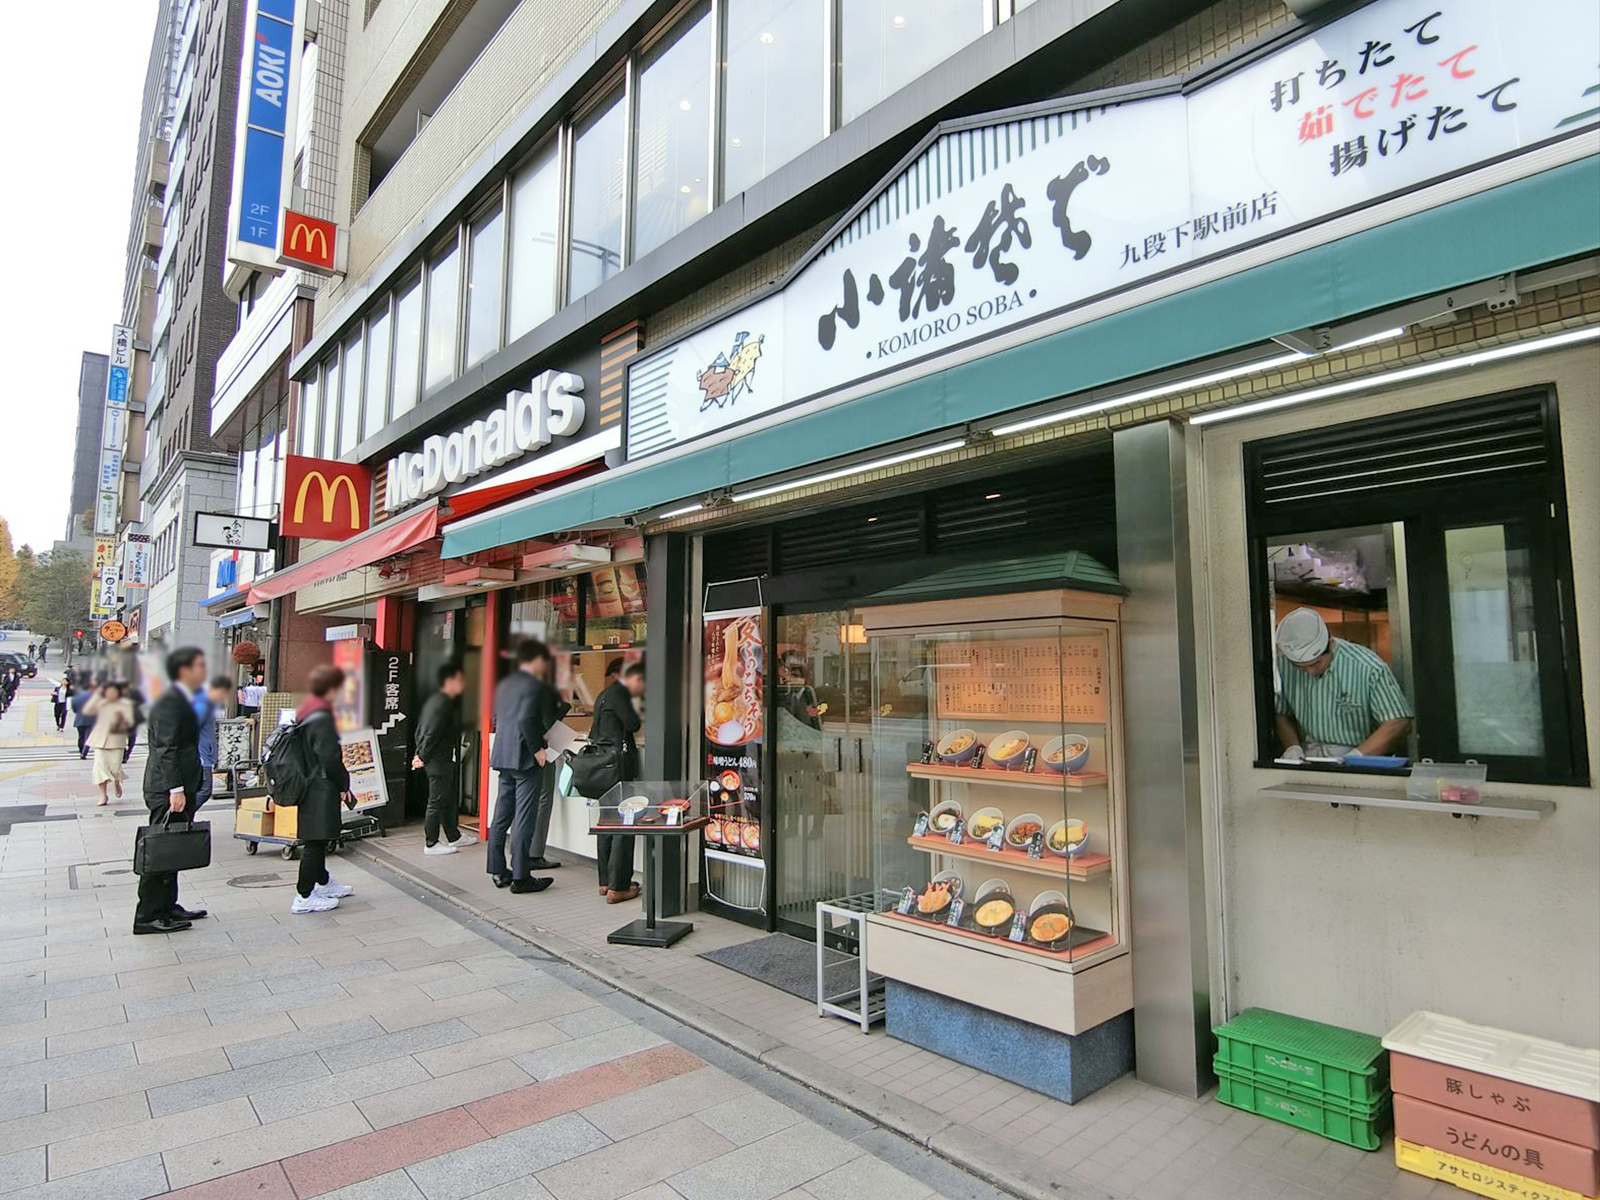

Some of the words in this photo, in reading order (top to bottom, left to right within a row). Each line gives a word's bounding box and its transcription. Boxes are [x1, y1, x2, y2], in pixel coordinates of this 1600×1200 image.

[255, 45, 286, 108] AOKI
[1270, 11, 1442, 112] 打ちたて
[1298, 44, 1478, 145] 茹でたて
[1329, 77, 1520, 177] 揚げたて
[250, 203, 270, 216] 2F
[250, 225, 268, 238] 1F
[1119, 190, 1279, 270] 九段下駅前店
[115, 328, 128, 364] 大橋ビル
[877, 314, 962, 360] KOMORO
[966, 290, 1024, 326] SOBA
[384, 369, 586, 512] McDonald's
[384, 656, 400, 711] 2F客席
[1445, 1077, 1532, 1113] 豚しゃぶ
[1446, 1126, 1546, 1171] うどんの具
